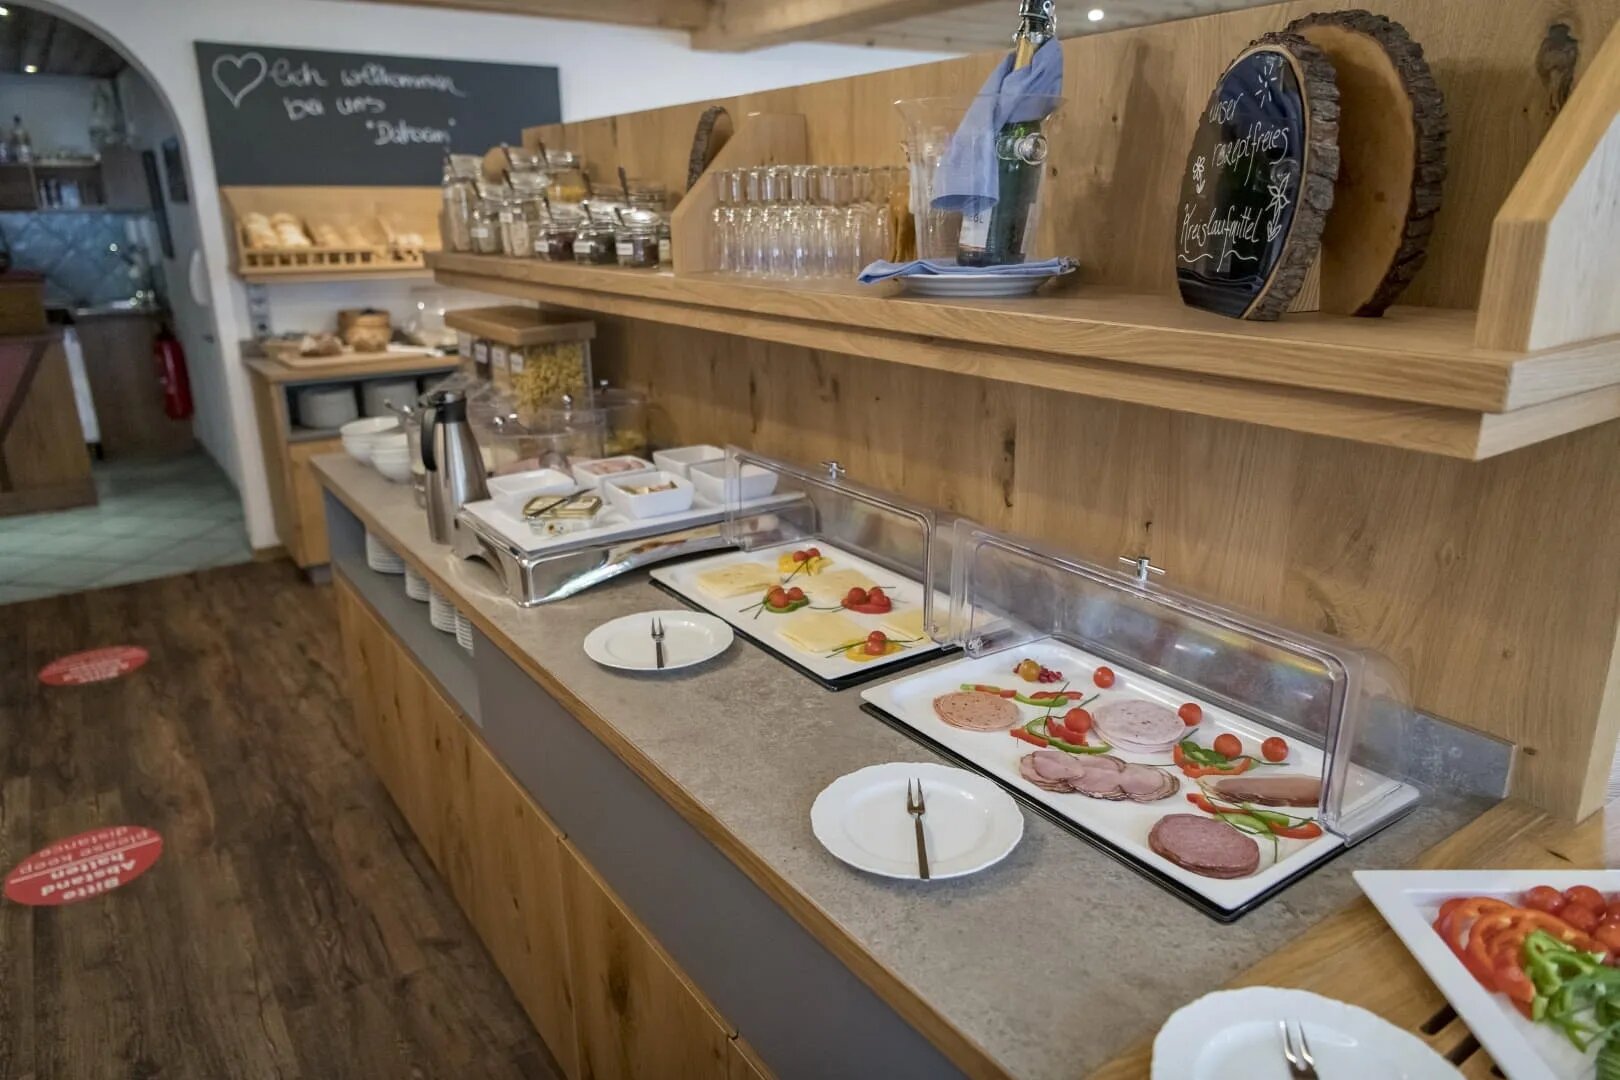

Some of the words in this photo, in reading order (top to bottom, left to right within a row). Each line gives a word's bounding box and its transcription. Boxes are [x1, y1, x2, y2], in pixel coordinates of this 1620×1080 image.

[341, 62, 466, 97] willkommen
[335, 96, 387, 116] uns
[1209, 92, 1244, 124] unser
[1211, 121, 1290, 187] rezeptfreies
[1180, 203, 1264, 273] Kreislaufmittel
[39, 826, 128, 858] distance
[79, 828, 148, 857] please
[19, 853, 73, 875] keep
[41, 859, 136, 897] Abstand
[51, 852, 125, 880] halten
[62, 876, 120, 900] Bitte
